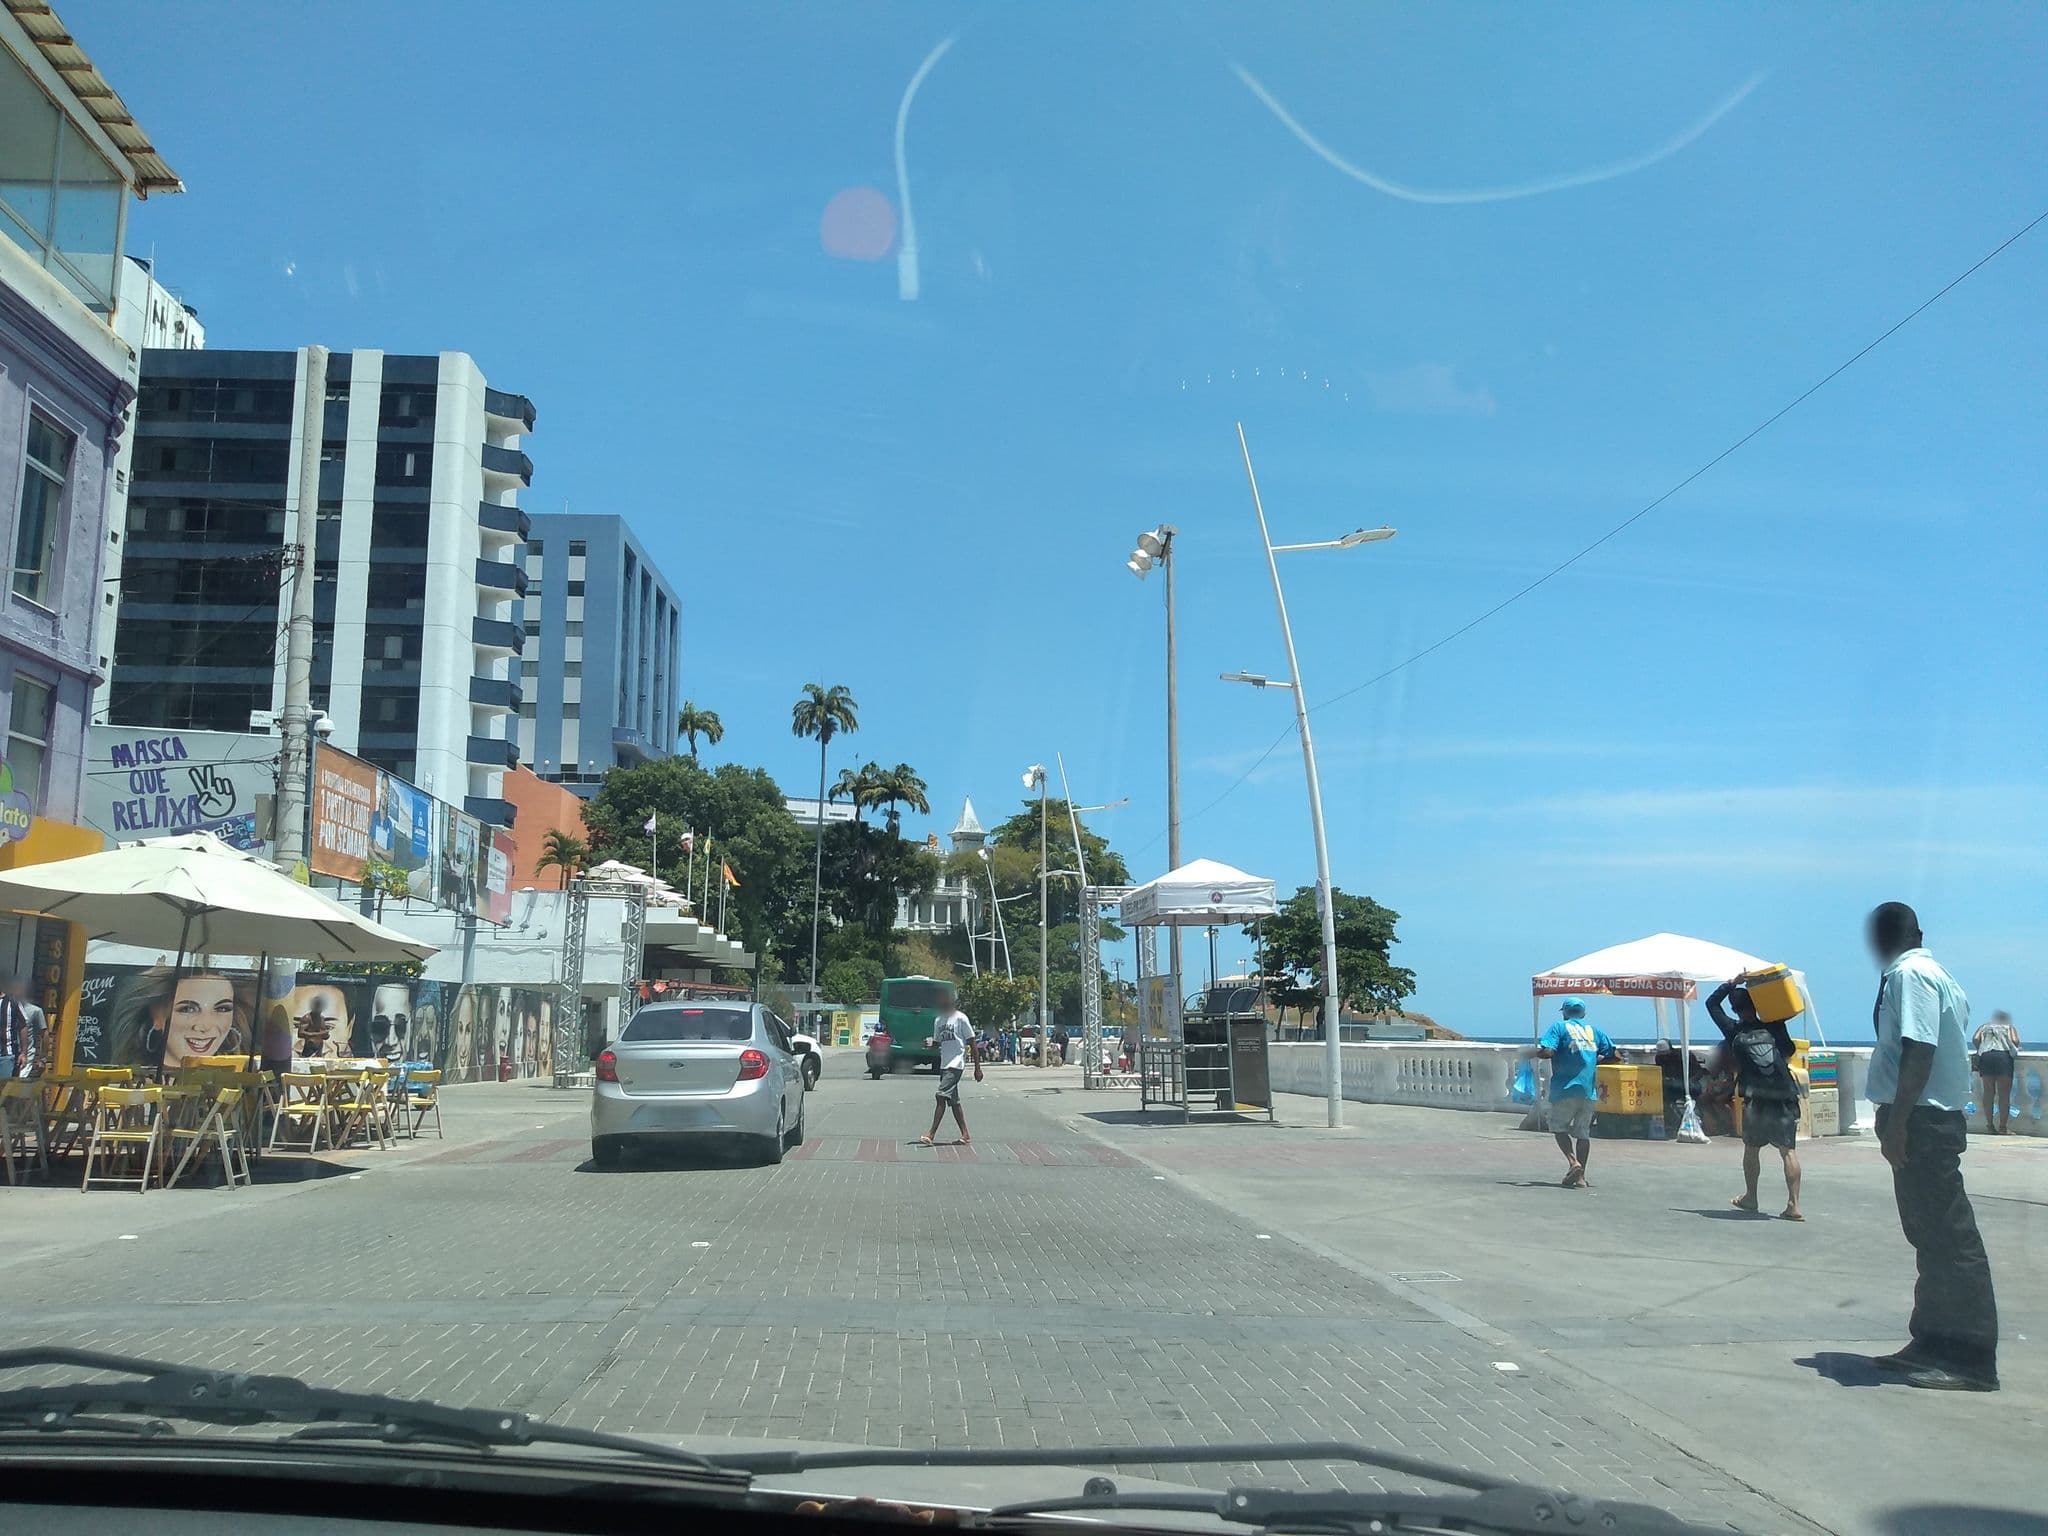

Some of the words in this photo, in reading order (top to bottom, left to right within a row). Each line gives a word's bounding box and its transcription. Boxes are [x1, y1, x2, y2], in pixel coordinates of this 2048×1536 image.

[111, 736, 188, 769] MASCA
[129, 767, 170, 796] QUE
[112, 794, 201, 832] RELAXA
[319, 820, 336, 852] POR
[337, 824, 369, 861] SEMANA
[1567, 979, 1581, 988] DE
[1609, 979, 1620, 988] DE
